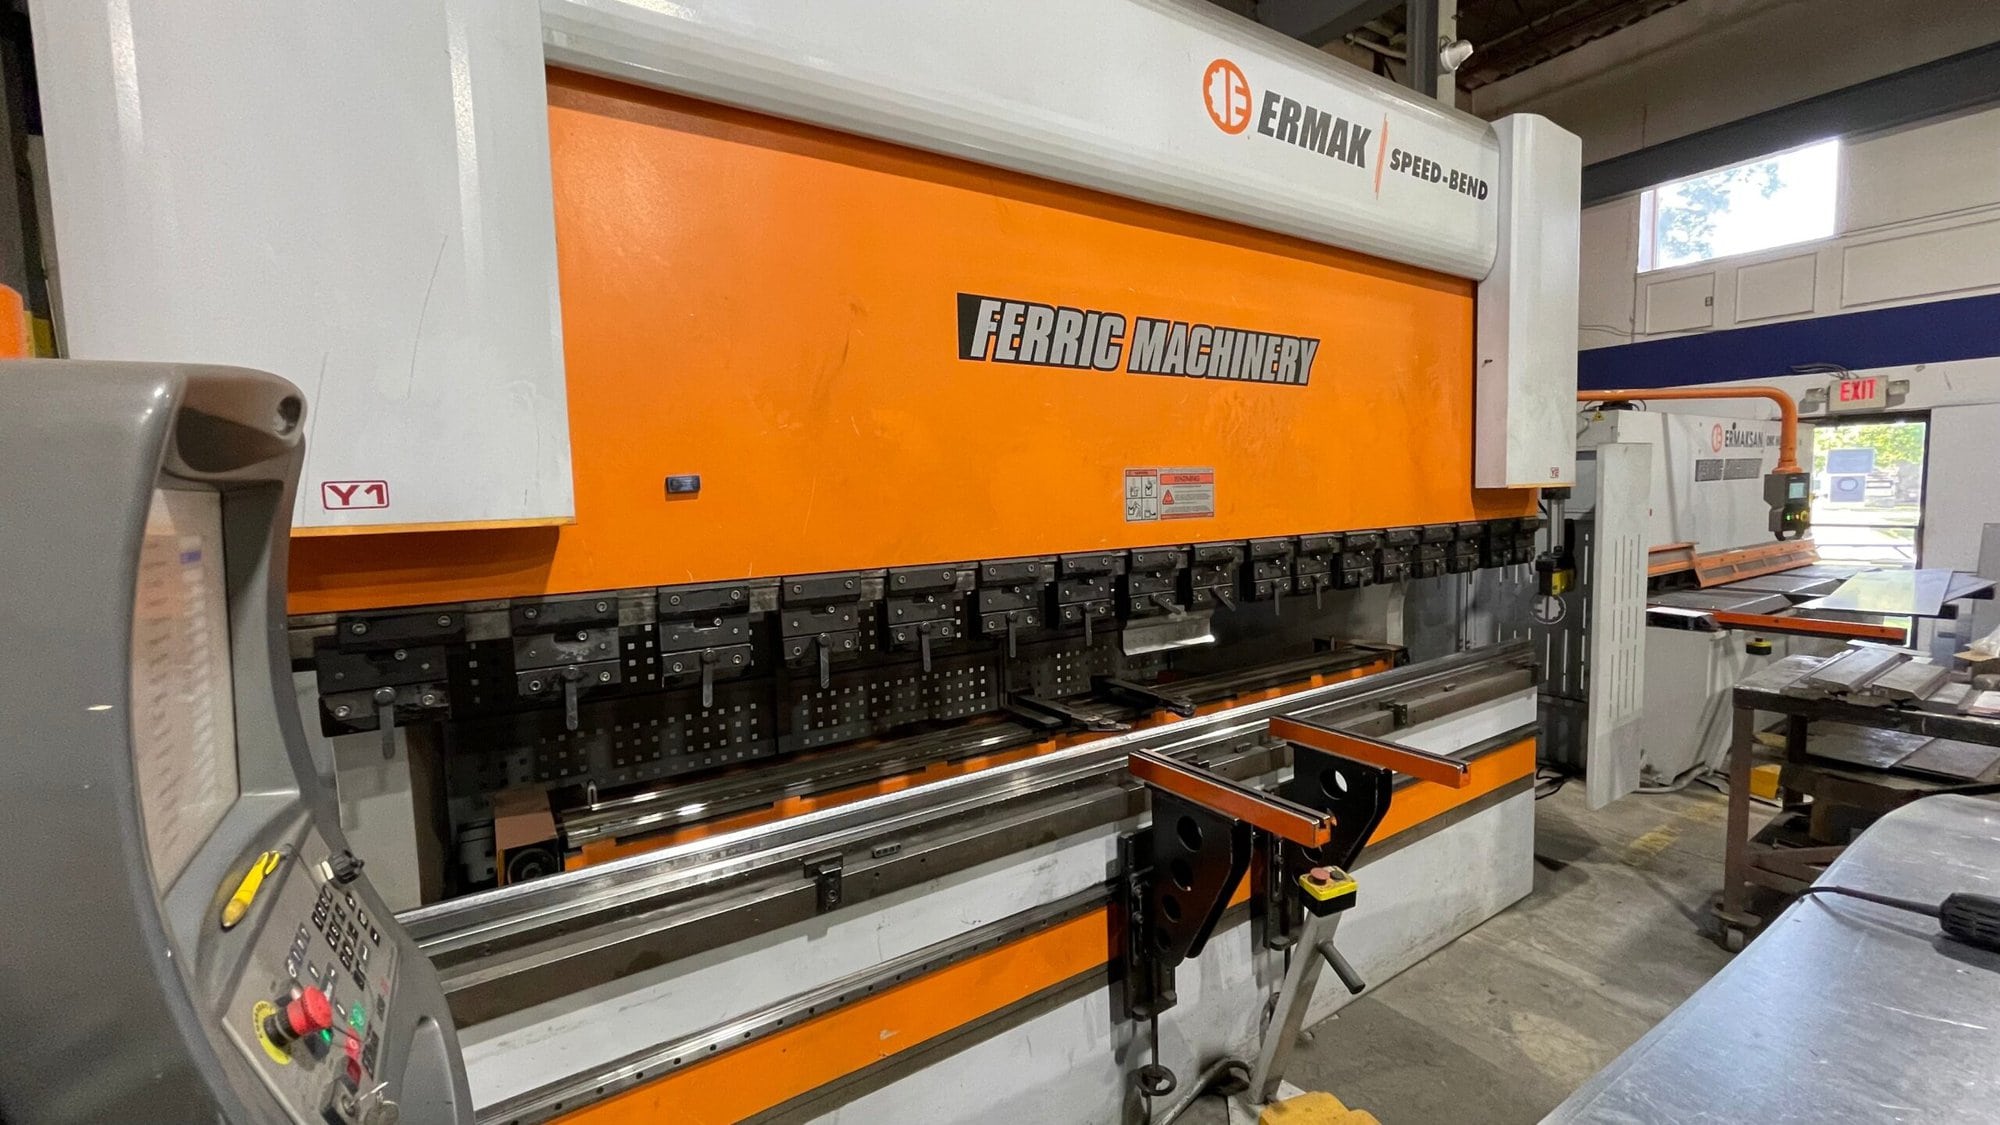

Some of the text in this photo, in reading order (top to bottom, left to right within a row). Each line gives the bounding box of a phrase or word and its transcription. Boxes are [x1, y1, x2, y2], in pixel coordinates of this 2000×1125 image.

[1256, 89, 1489, 202] ERMAK SPEED-BEND
[969, 298, 1319, 385] FERRIC MACHINERY
[1840, 379, 1877, 402] EXIT
[1724, 429, 1764, 448] ERMAKSAN
[326, 484, 385, 506] Y1
